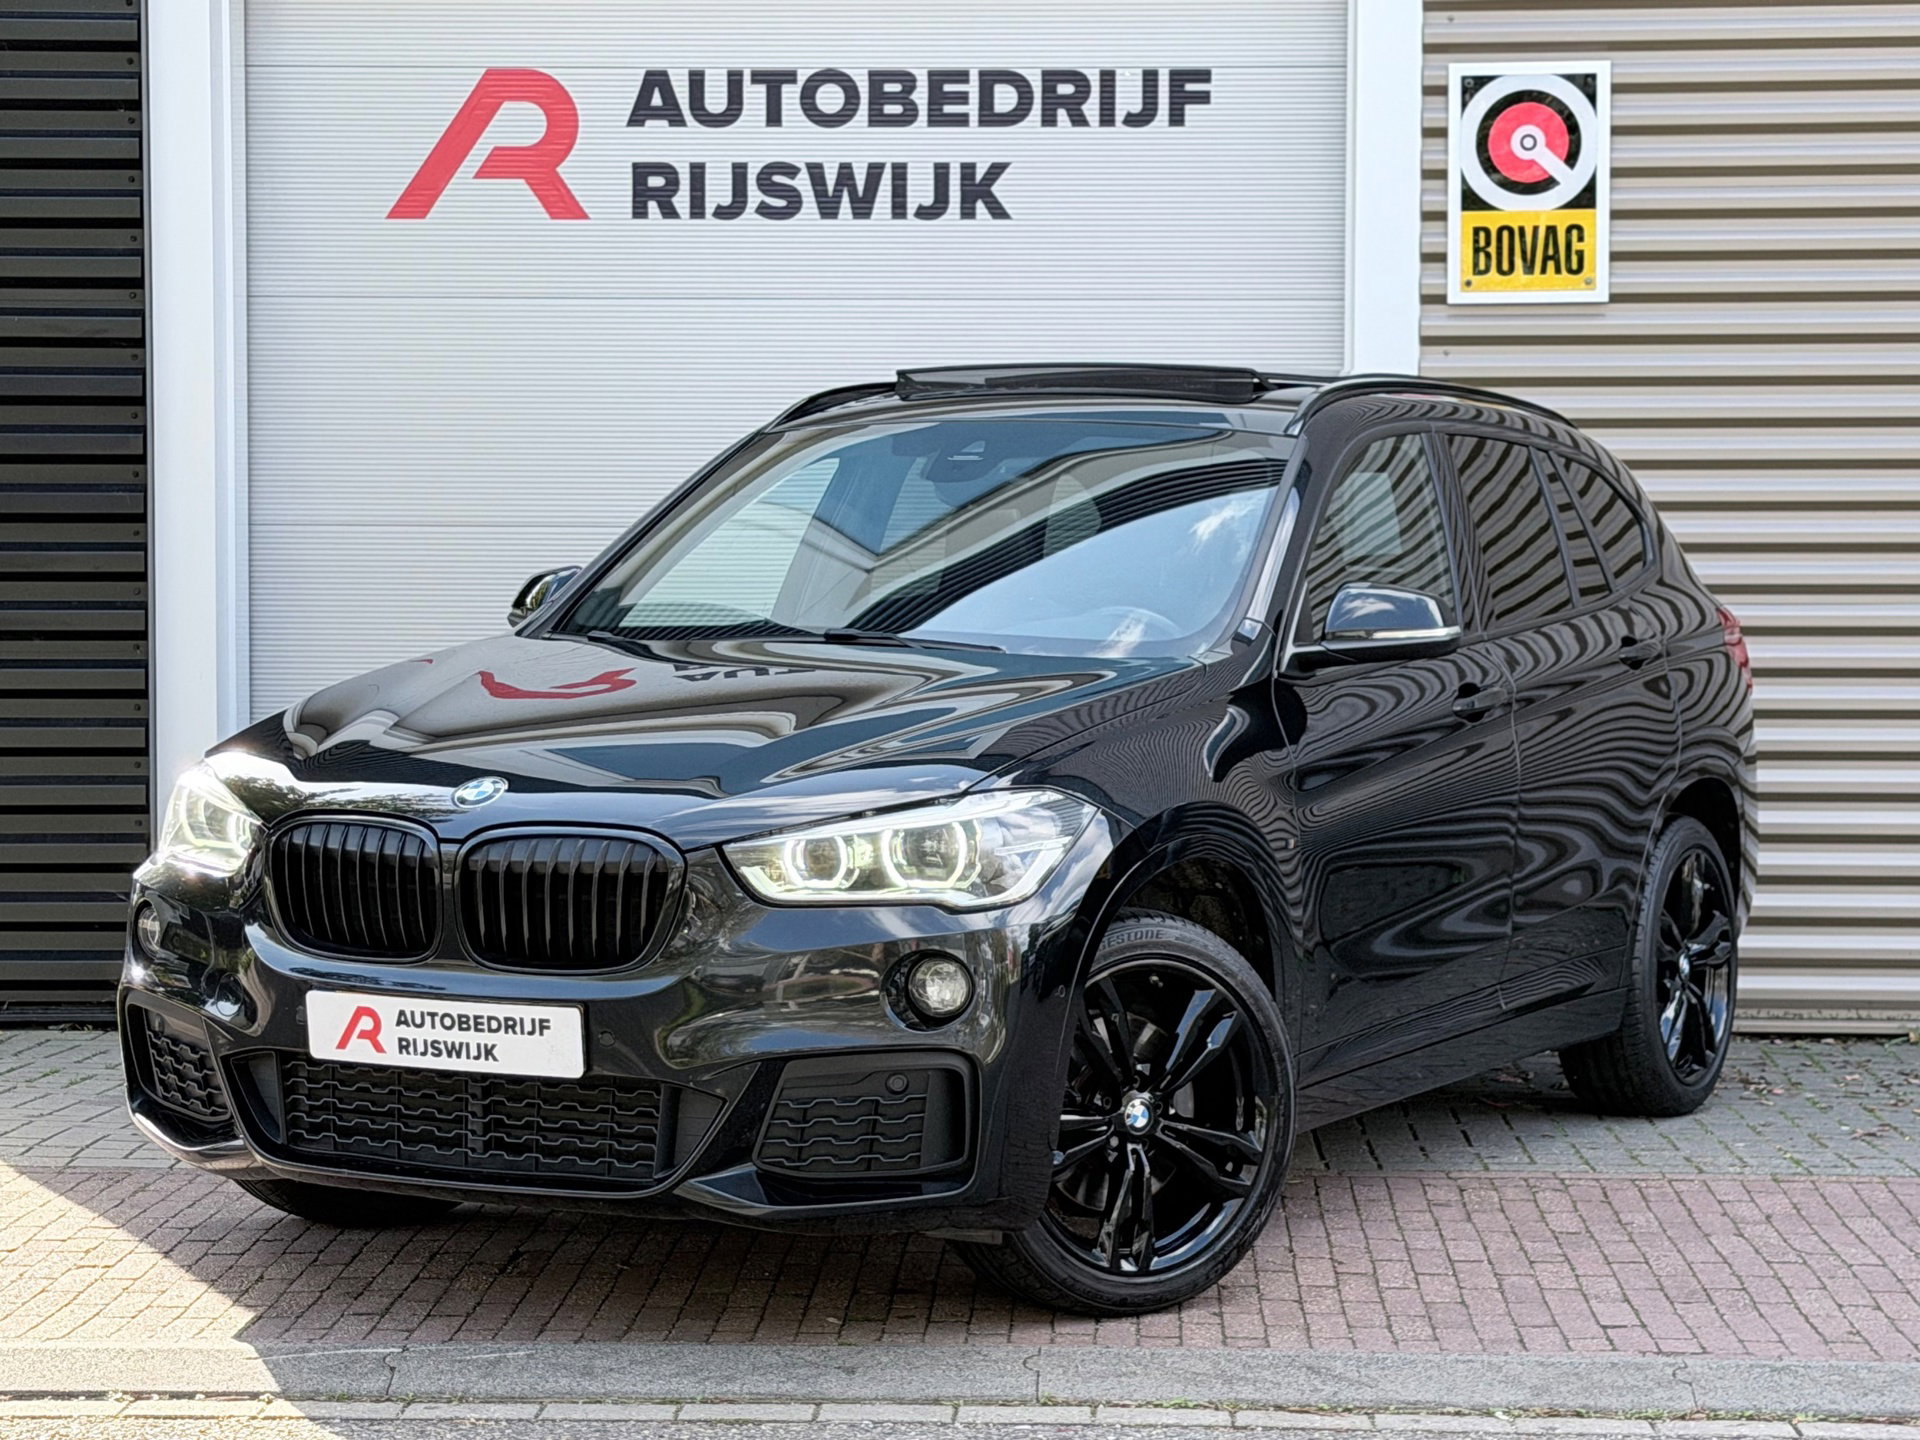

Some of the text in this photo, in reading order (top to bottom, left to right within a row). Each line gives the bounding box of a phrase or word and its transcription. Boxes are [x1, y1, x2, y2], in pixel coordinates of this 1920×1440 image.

[627, 68, 1212, 127] AUTOBEDRIJF
[631, 162, 1012, 220] RIJSWIJK
[1472, 224, 1585, 277] BOVAG
[395, 1009, 551, 1037] AUTOBEDRIJF
[396, 1037, 499, 1062] RIJSWIJK
